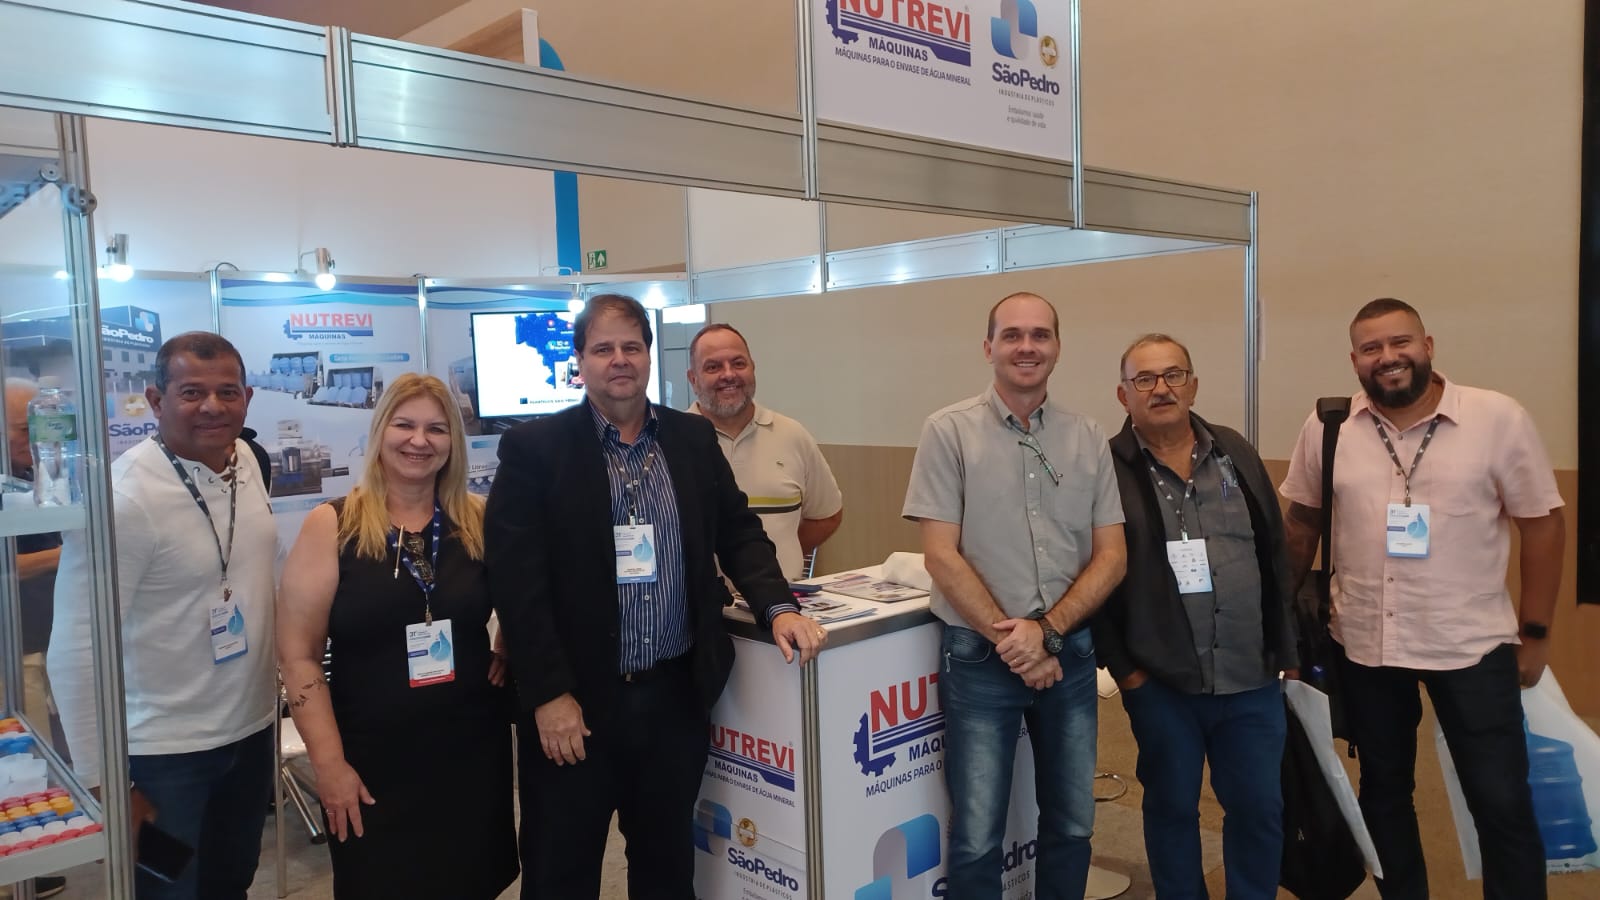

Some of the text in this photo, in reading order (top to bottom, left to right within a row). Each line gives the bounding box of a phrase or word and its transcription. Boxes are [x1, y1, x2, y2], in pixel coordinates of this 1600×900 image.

[834, 46, 972, 86] MÁQUINAS PARA O ENVASE DE ÁGUA MINERAL
[868, 36, 928, 62] MÁQUINAS
[992, 61, 1060, 95] SãoPedro
[101, 324, 154, 344] ãoPedro
[290, 313, 373, 327] NUTREVI
[108, 422, 159, 437] SãoP
[870, 672, 943, 733] NUT
[709, 724, 795, 773] UTREVI
[714, 759, 759, 783] MÁQUINAS
[866, 759, 942, 798] MÁQUINAS PARA O
[727, 846, 799, 892] SãoPedro
